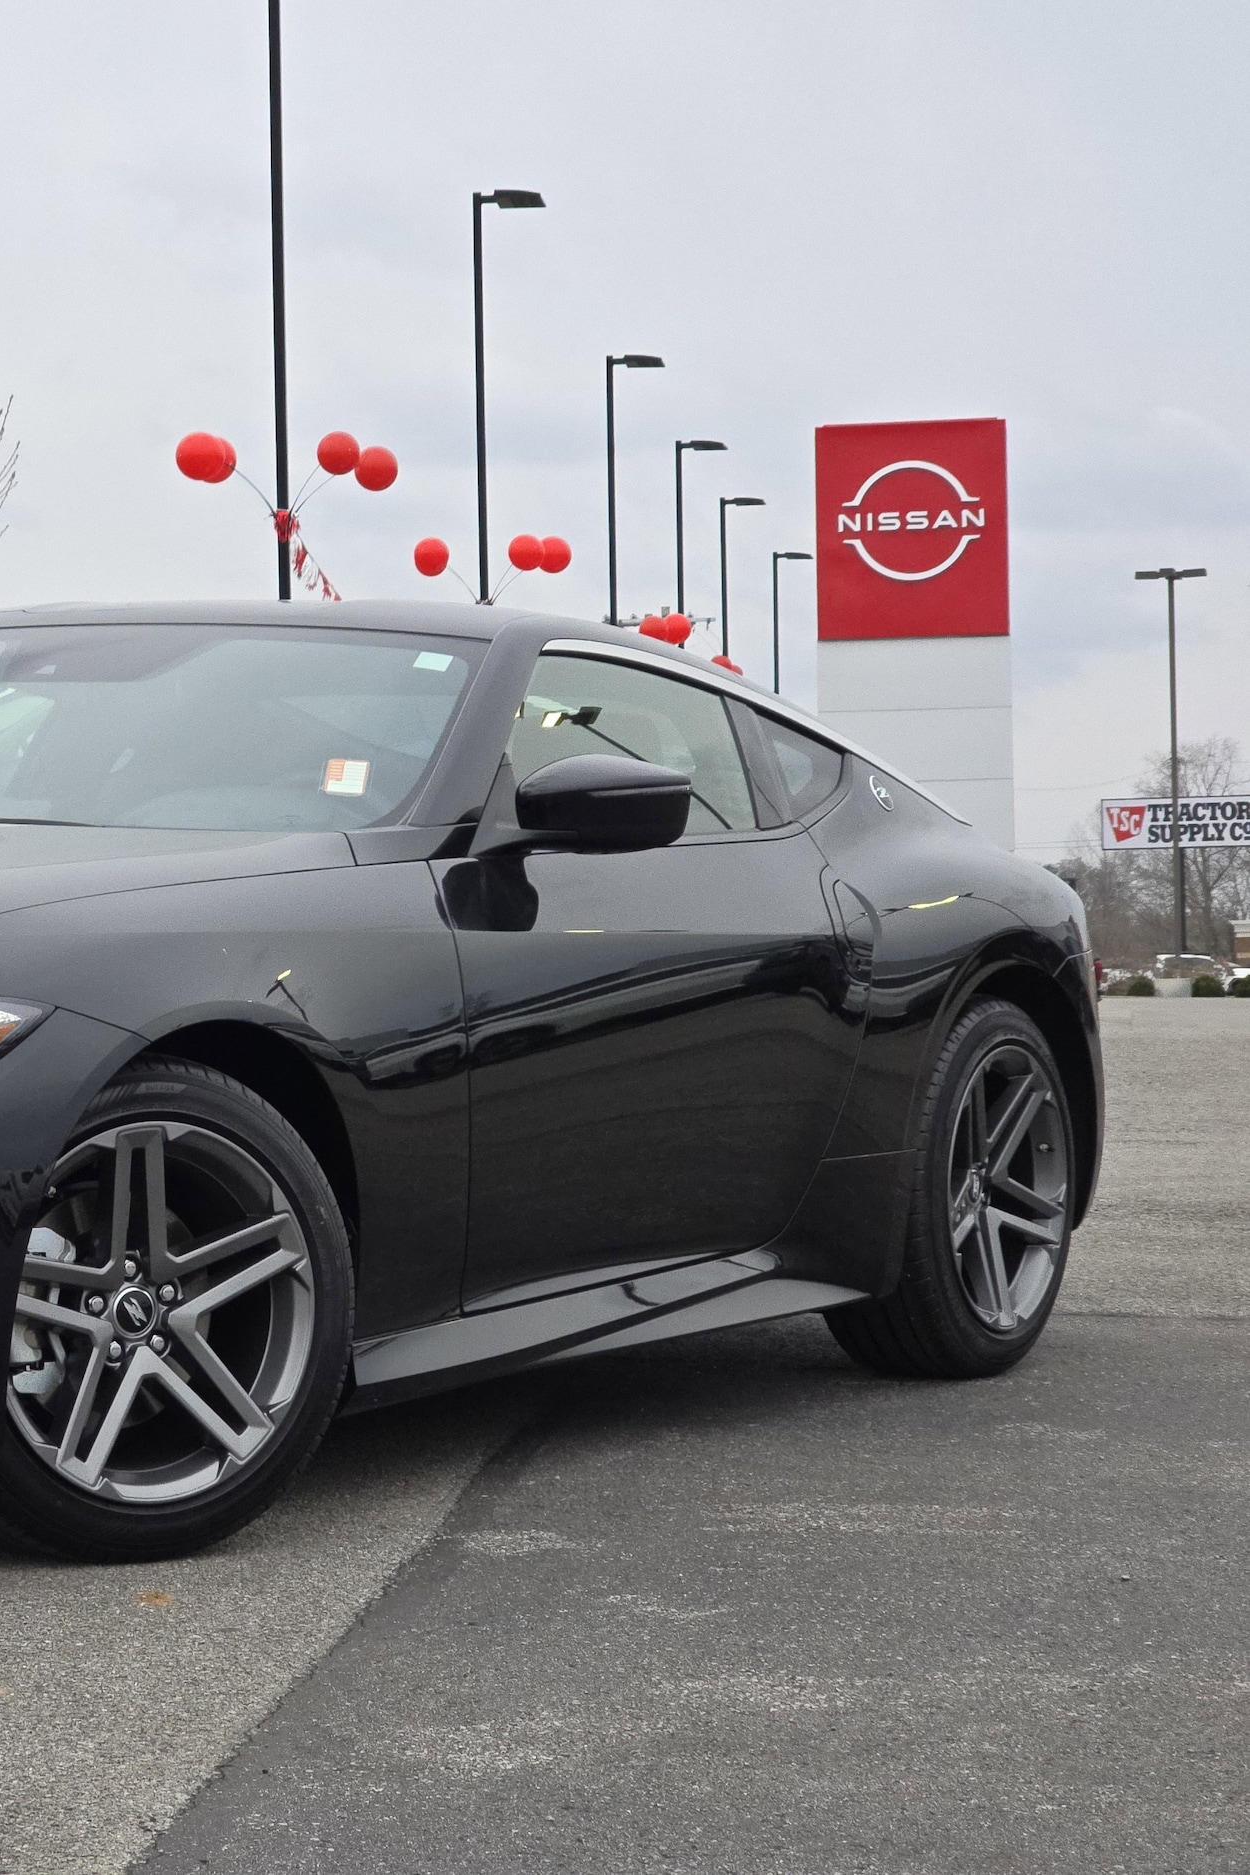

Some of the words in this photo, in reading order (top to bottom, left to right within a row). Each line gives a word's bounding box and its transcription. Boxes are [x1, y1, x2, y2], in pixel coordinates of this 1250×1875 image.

[837, 508, 985, 533] NISSAN
[1110, 807, 1140, 836] TSC
[1148, 802, 1250, 822] TRACTOR
[1148, 823, 1227, 843] SUPPLY
